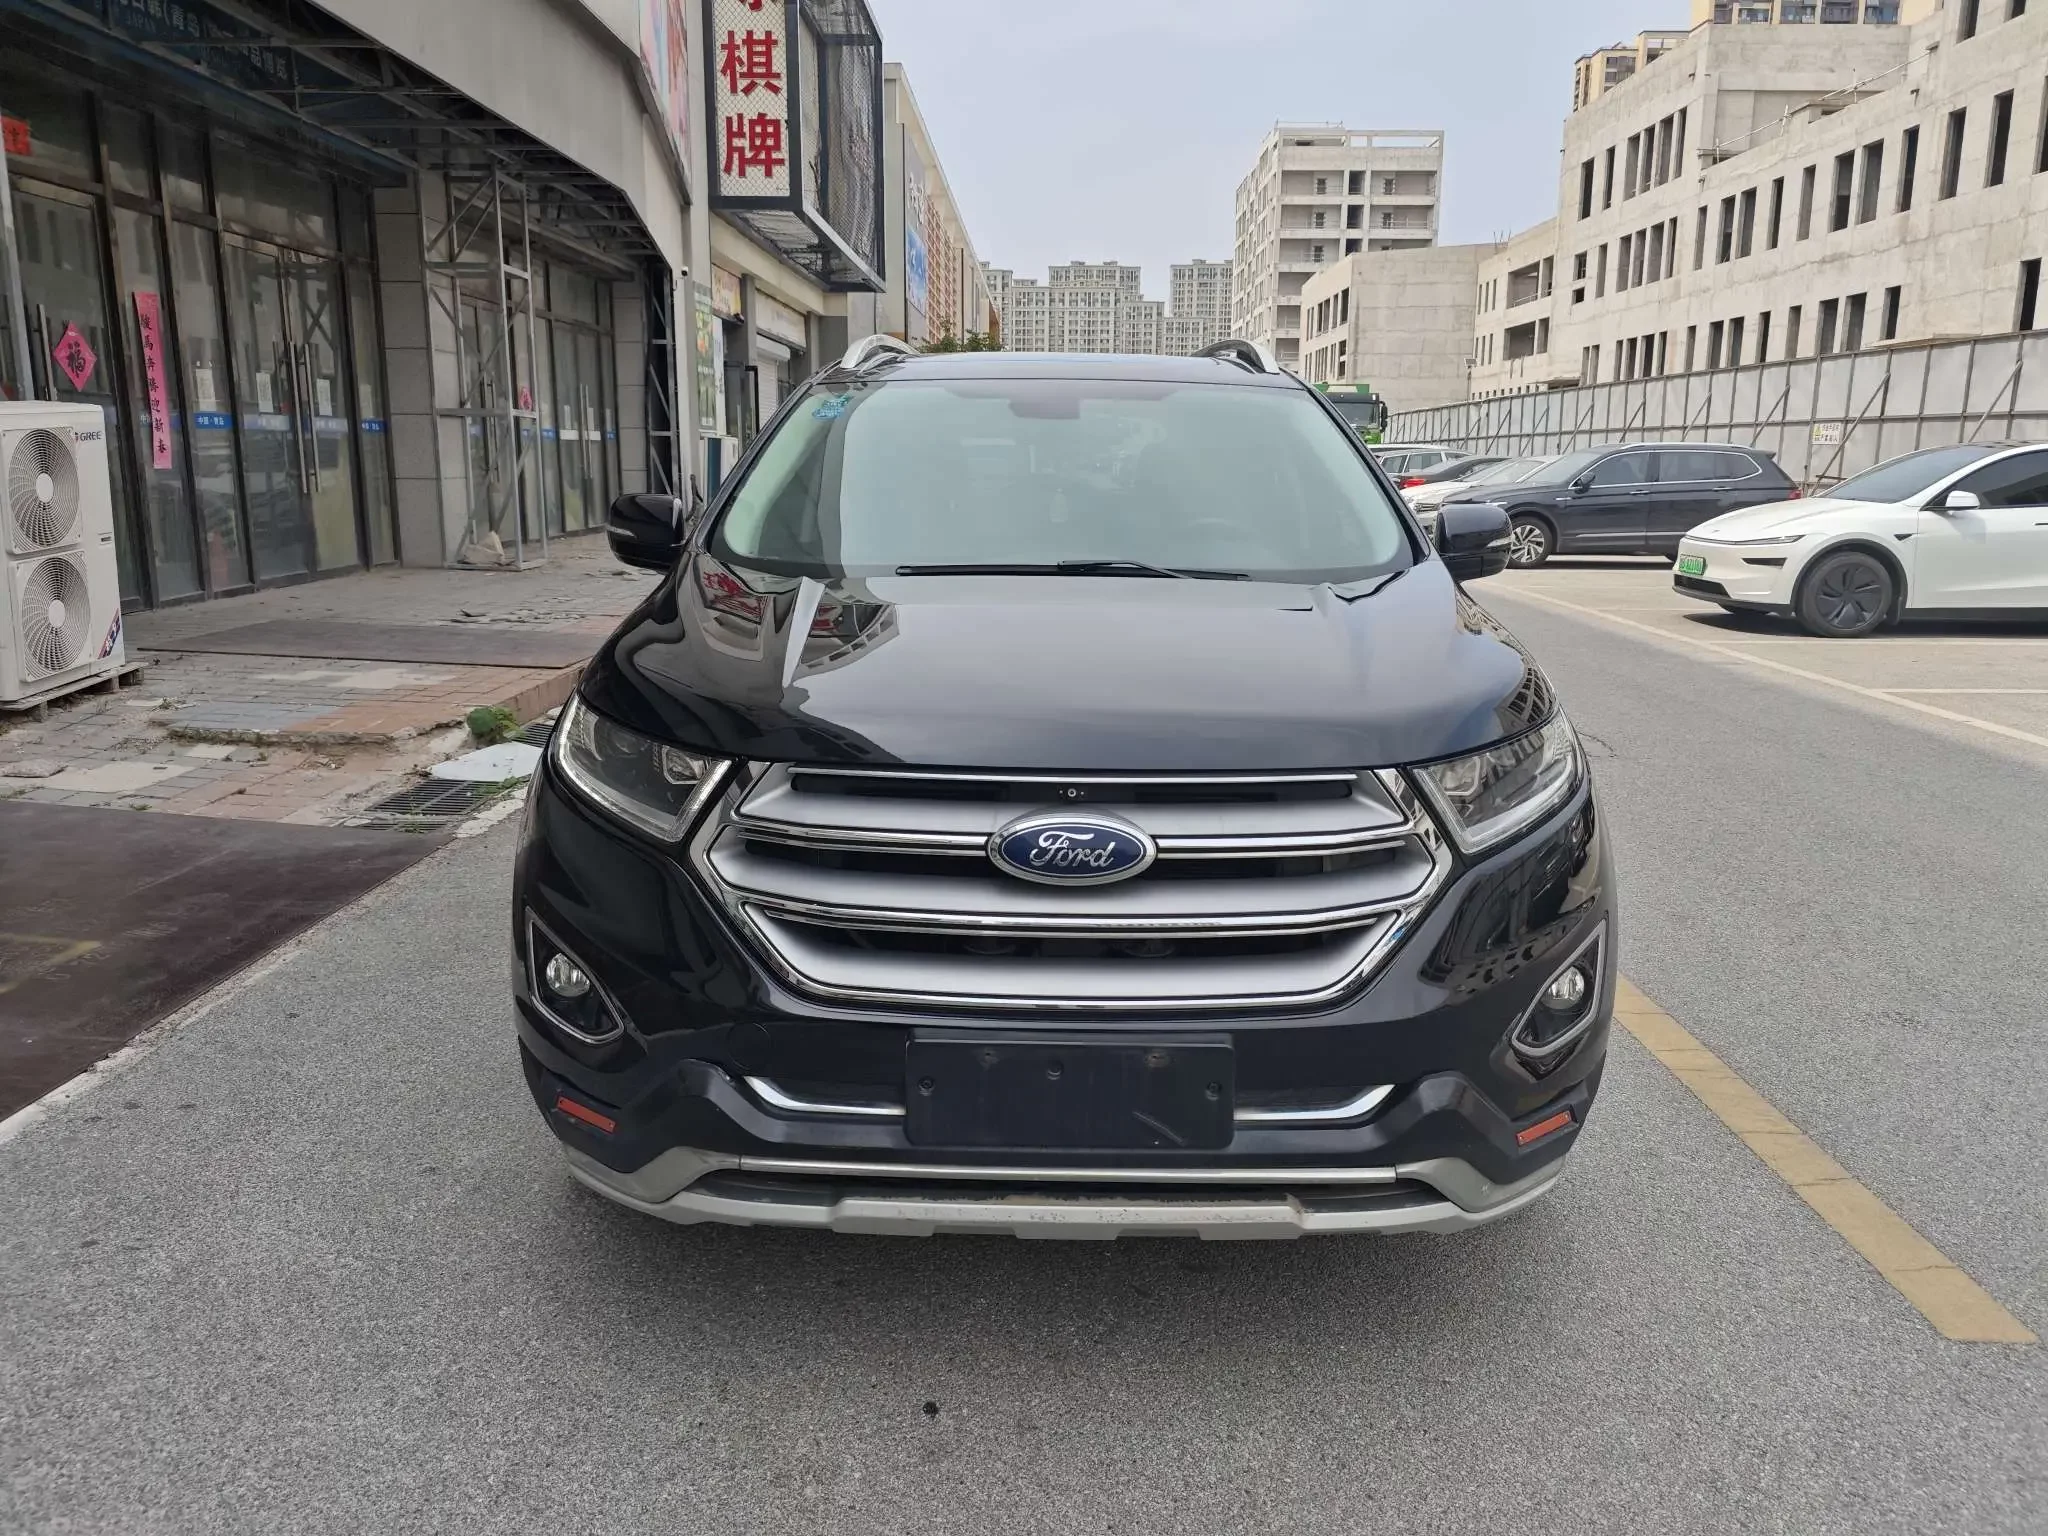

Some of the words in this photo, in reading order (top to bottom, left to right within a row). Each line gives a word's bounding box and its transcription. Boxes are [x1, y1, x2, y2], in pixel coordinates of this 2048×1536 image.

[720, 0, 786, 178] 棋牌
[80, 431, 103, 442] GREE
[1029, 830, 1116, 867] Ford
